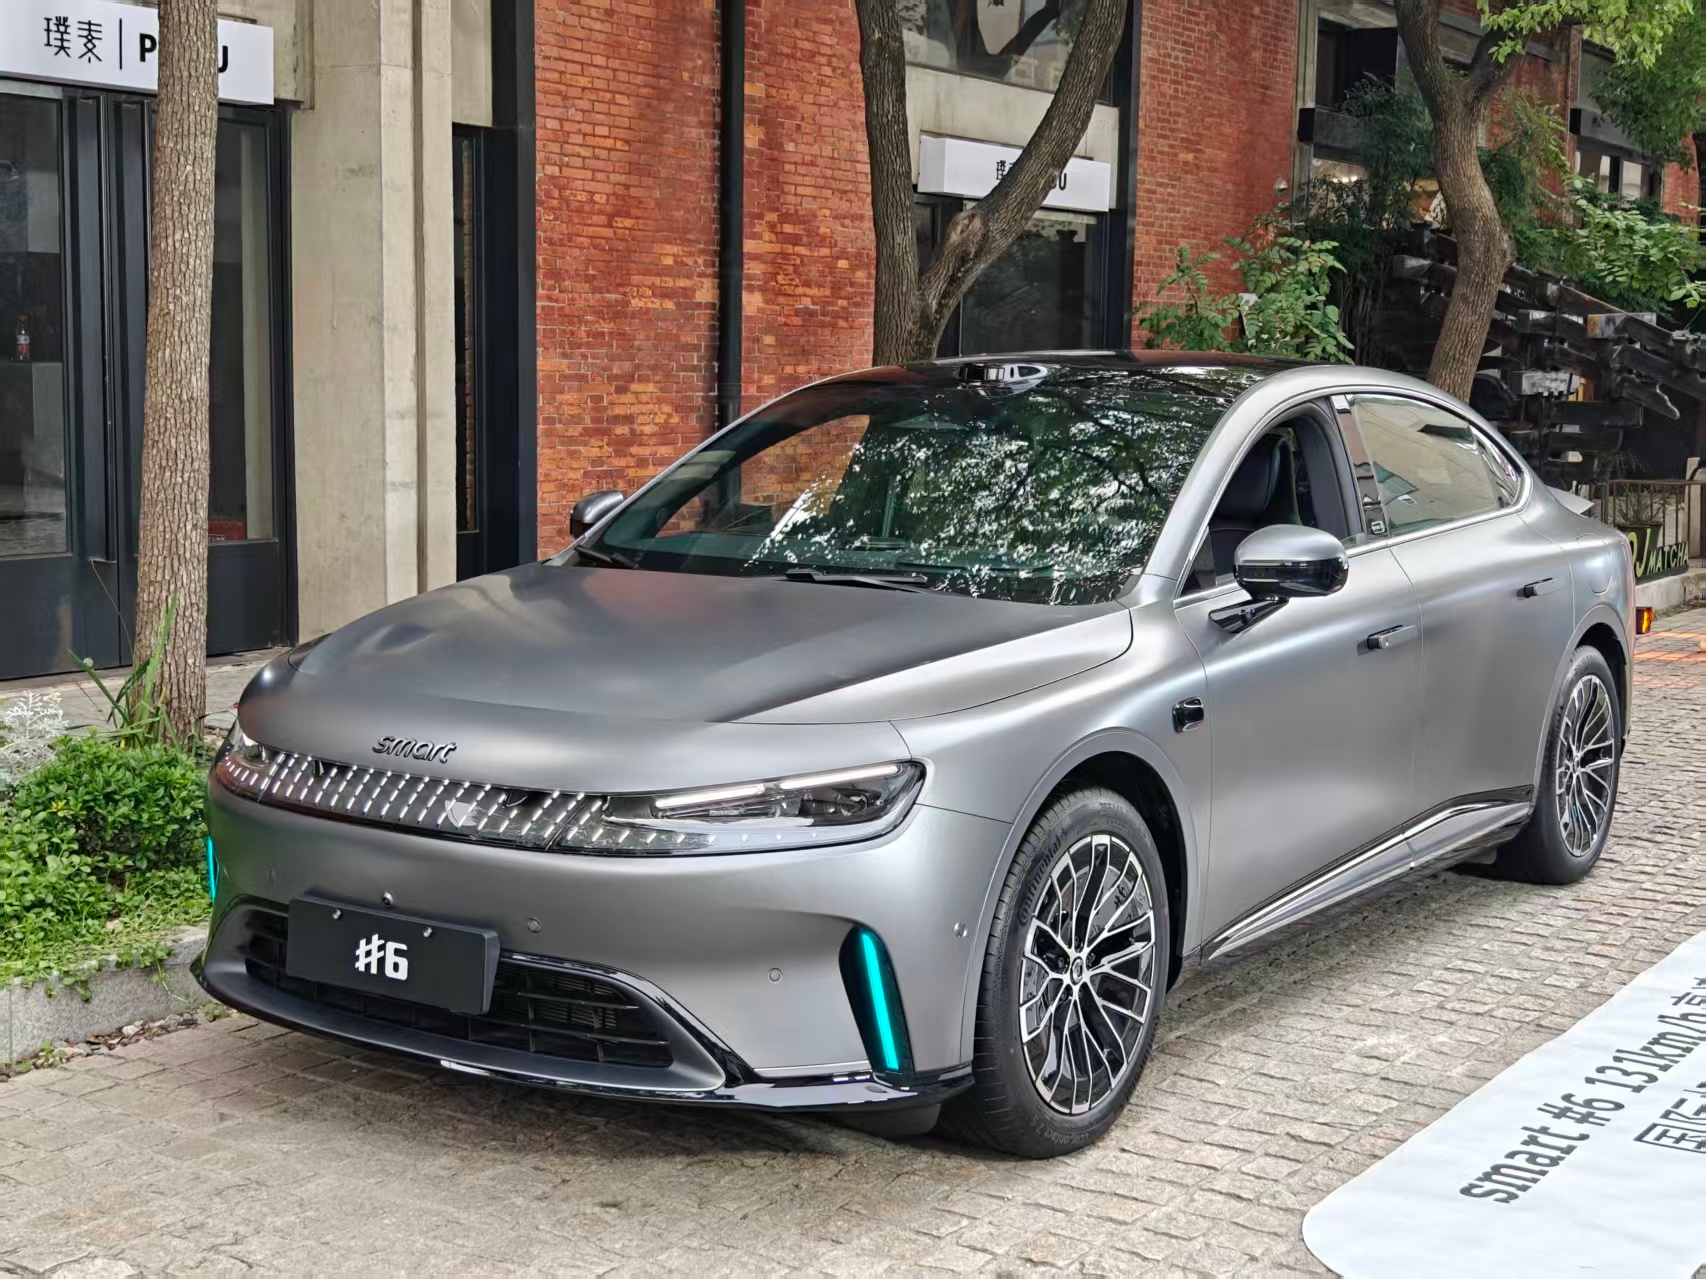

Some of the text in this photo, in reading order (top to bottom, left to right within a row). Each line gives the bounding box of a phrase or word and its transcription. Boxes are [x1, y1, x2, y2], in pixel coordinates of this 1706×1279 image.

[1646, 541, 1689, 577] MATCHA
[372, 735, 457, 764] smart
[354, 933, 409, 981] #6
[1459, 1125, 1590, 1204] smart
[1537, 1093, 1625, 1127] #6
